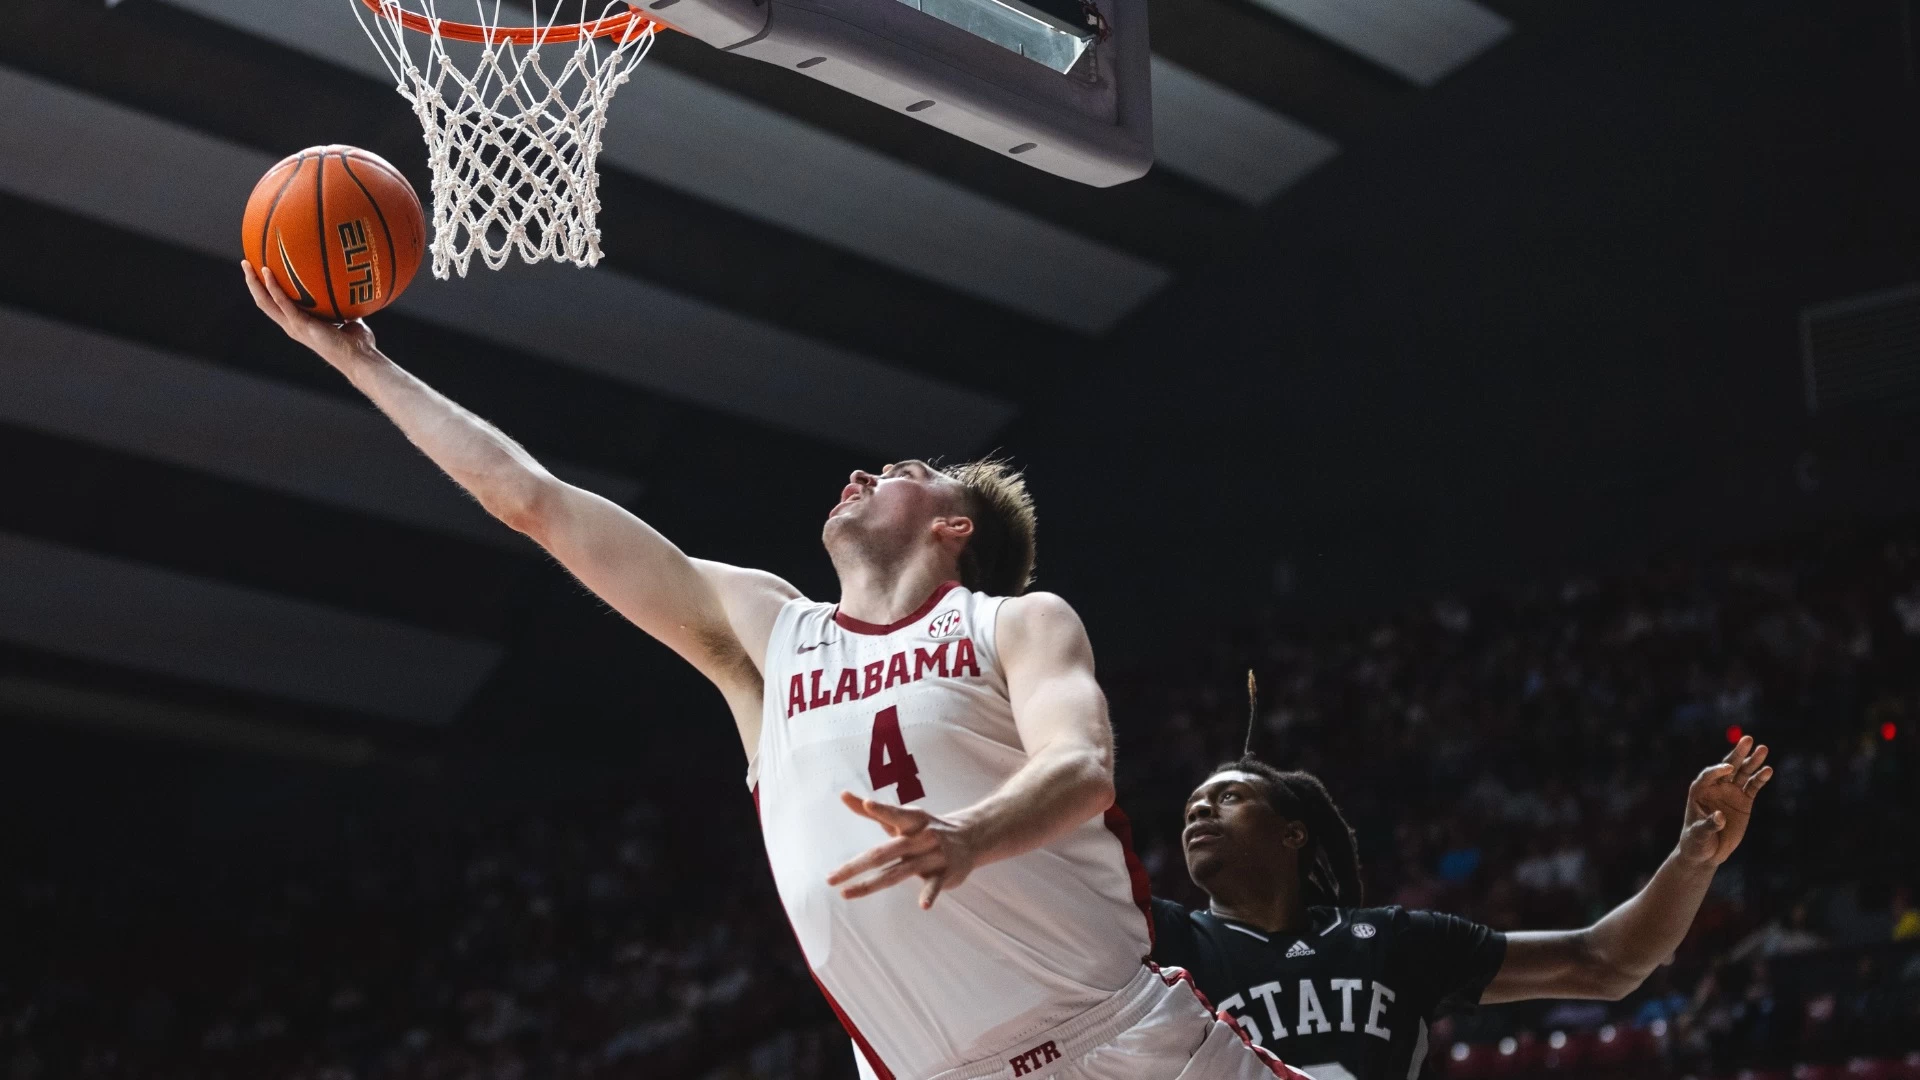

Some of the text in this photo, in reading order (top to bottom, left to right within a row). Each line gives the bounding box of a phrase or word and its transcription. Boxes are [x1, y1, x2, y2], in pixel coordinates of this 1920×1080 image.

[336, 219, 375, 306] ELITE
[930, 611, 961, 638] SEC
[787, 638, 981, 720] ALABAMA
[868, 705, 926, 806] 4
[1285, 949, 1316, 959] adidas
[1352, 924, 1376, 938] SEC
[1217, 978, 1396, 1046] STATE
[1008, 1040, 1062, 1078] RTR
